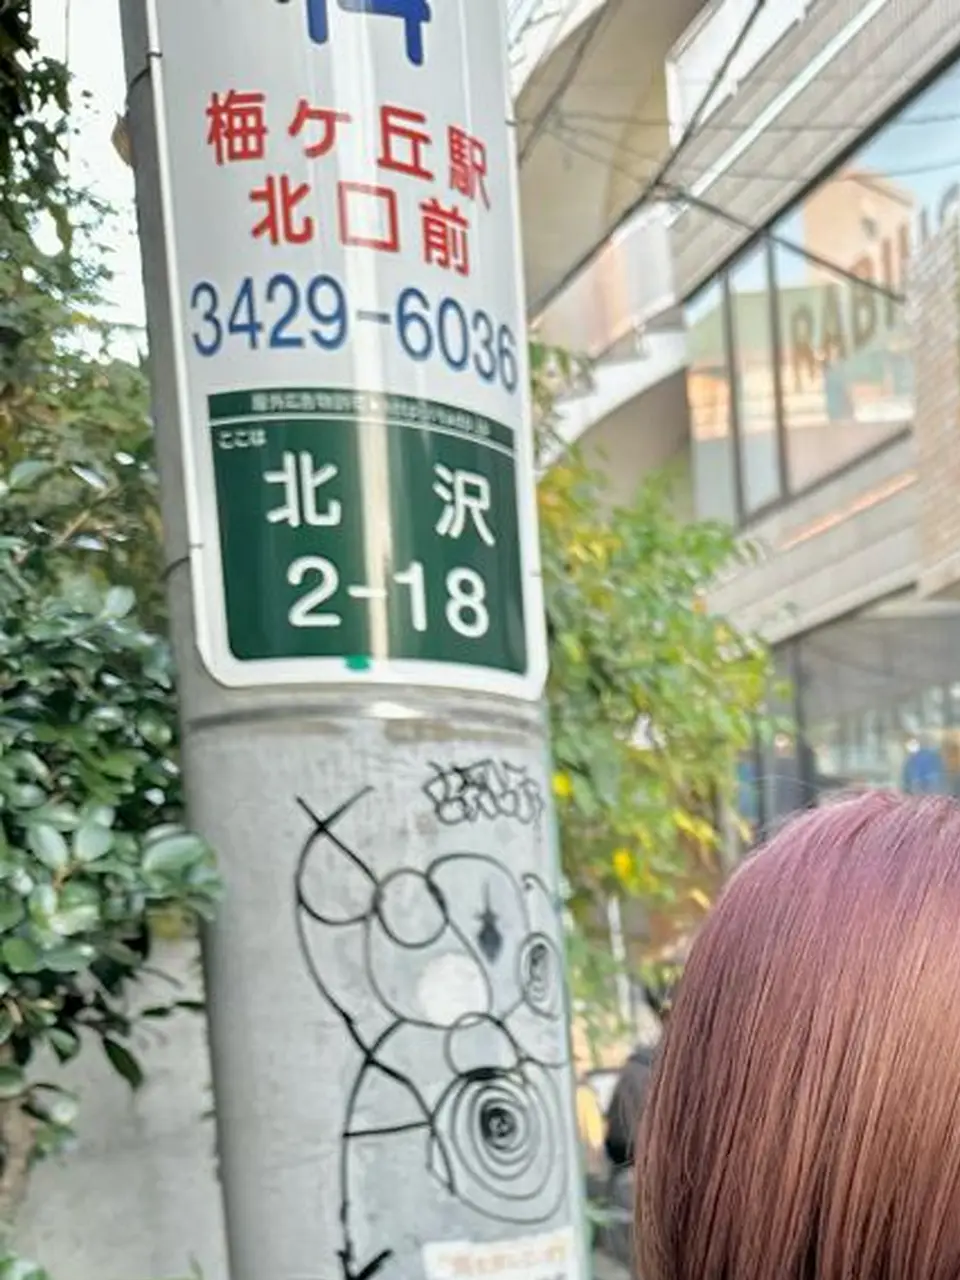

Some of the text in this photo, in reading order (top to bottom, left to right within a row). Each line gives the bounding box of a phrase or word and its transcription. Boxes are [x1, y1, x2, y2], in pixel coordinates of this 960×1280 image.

[249, 174, 470, 277] 北口前
[190, 273, 519, 394] 3429-6036
[263, 450, 495, 547] 北沢
[286, 555, 490, 638] 2-18
